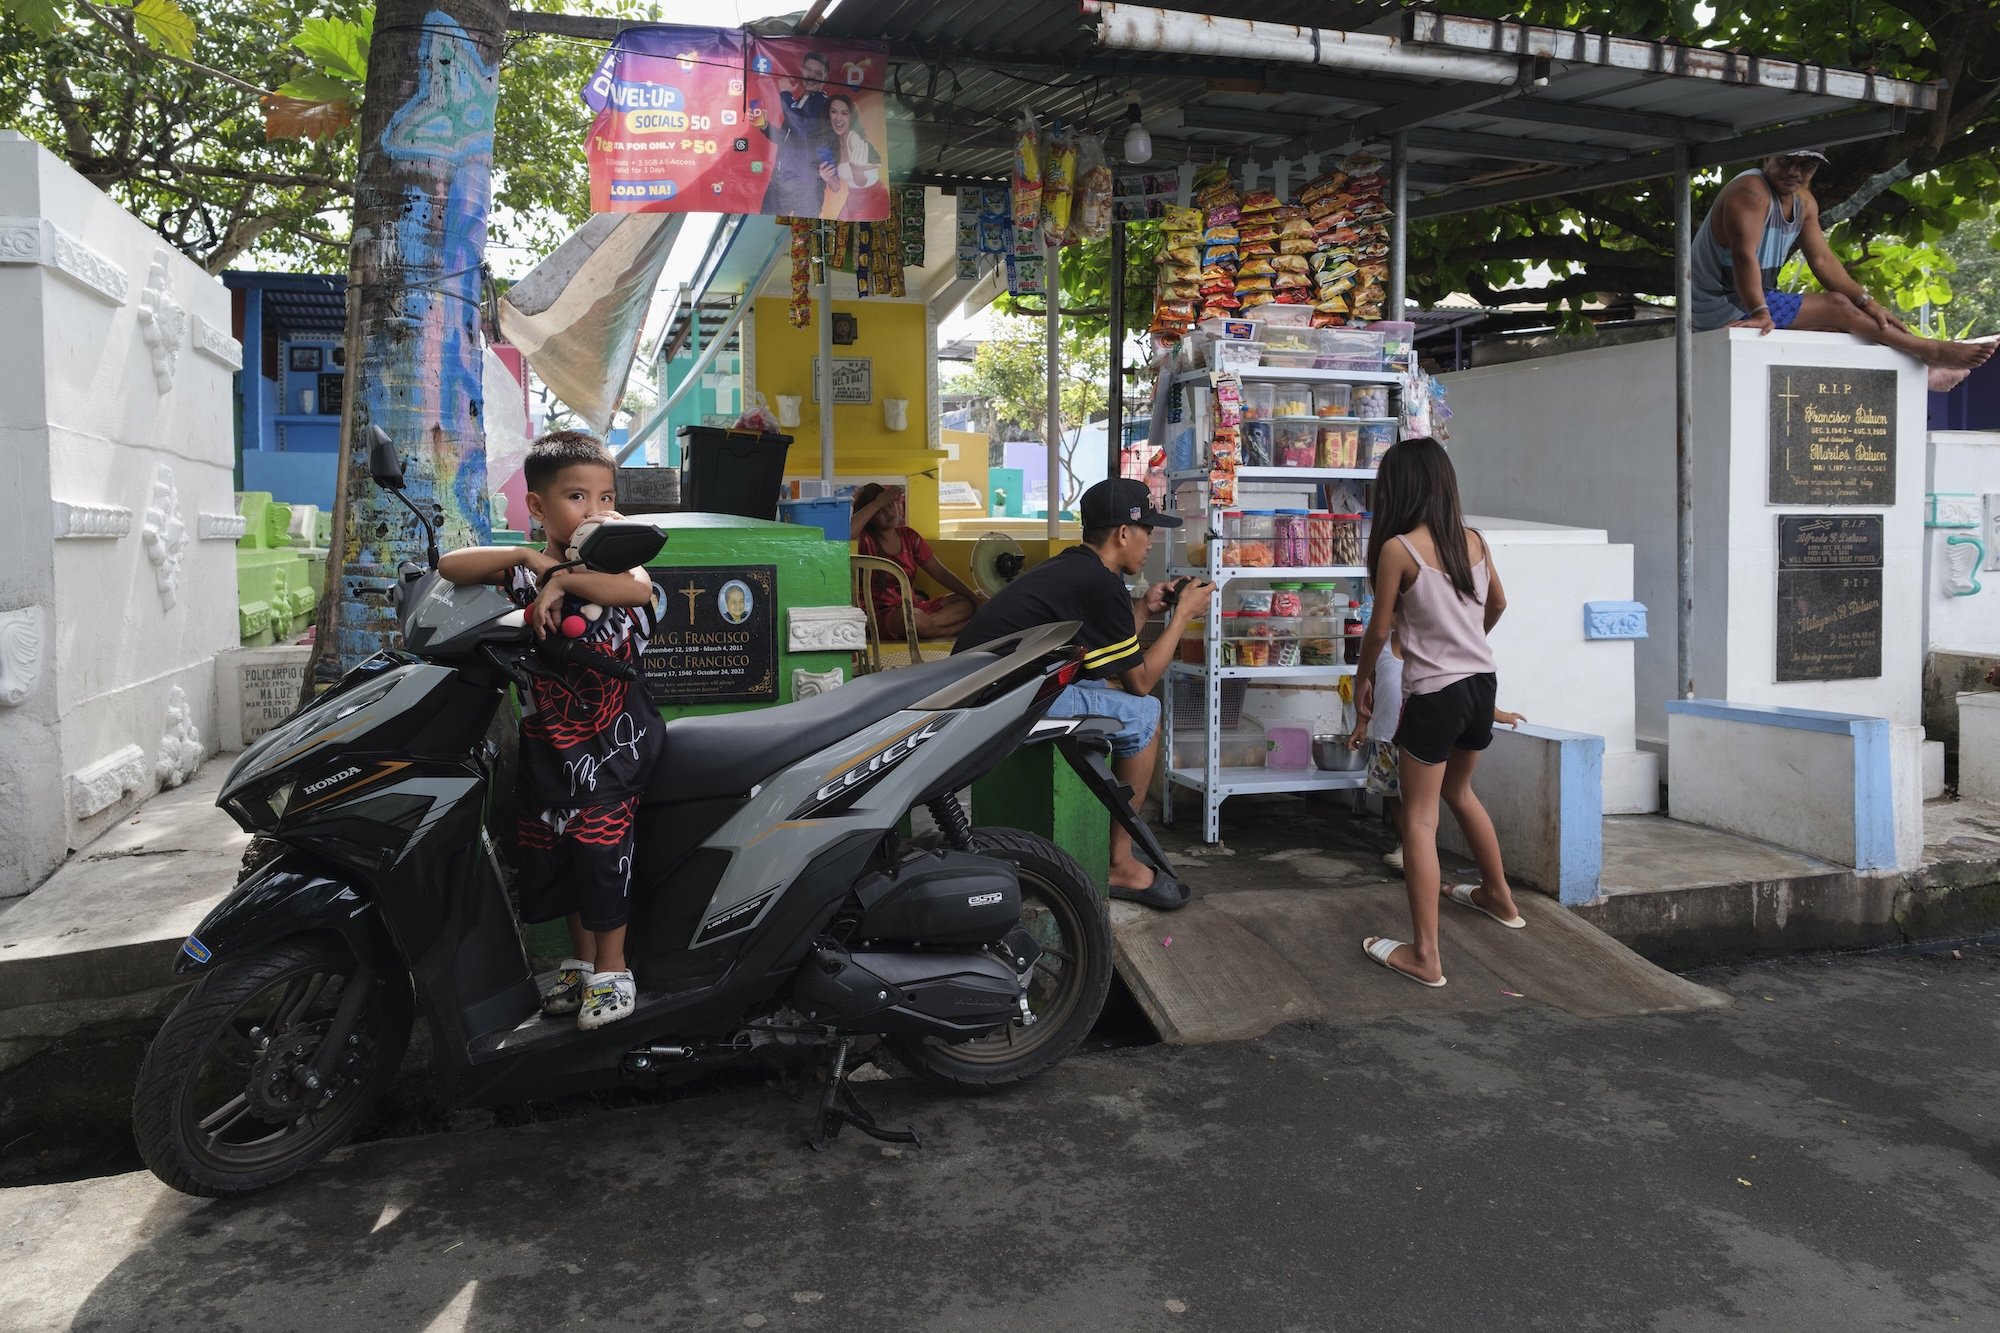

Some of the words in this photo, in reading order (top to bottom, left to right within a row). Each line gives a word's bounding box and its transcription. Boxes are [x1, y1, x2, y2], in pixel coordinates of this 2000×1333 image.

[635, 115, 684, 129] SOCIALS
[691, 115, 711, 130] 50
[626, 142, 647, 151] FOR
[648, 141, 676, 150] ONLY
[649, 167, 665, 175] Days
[610, 185, 646, 196] LOAD
[649, 185, 671, 196] NA!
[962, 188, 980, 197] Surf
[960, 222, 978, 231] Surf
[960, 254, 977, 262] Surf
[1804, 403, 1851, 423] Francisco
[669, 631, 681, 644] G.
[685, 631, 750, 644] FRANCISCO
[669, 656, 681, 669] C.
[685, 655, 750, 668] FRANCISCO
[245, 667, 297, 681] POLICARPIO
[260, 688, 272, 700] MA
[274, 687, 292, 699] LUZ
[263, 706, 290, 720] PABLO
[817, 722, 938, 801] CLICK
[303, 766, 362, 795] HONDA
